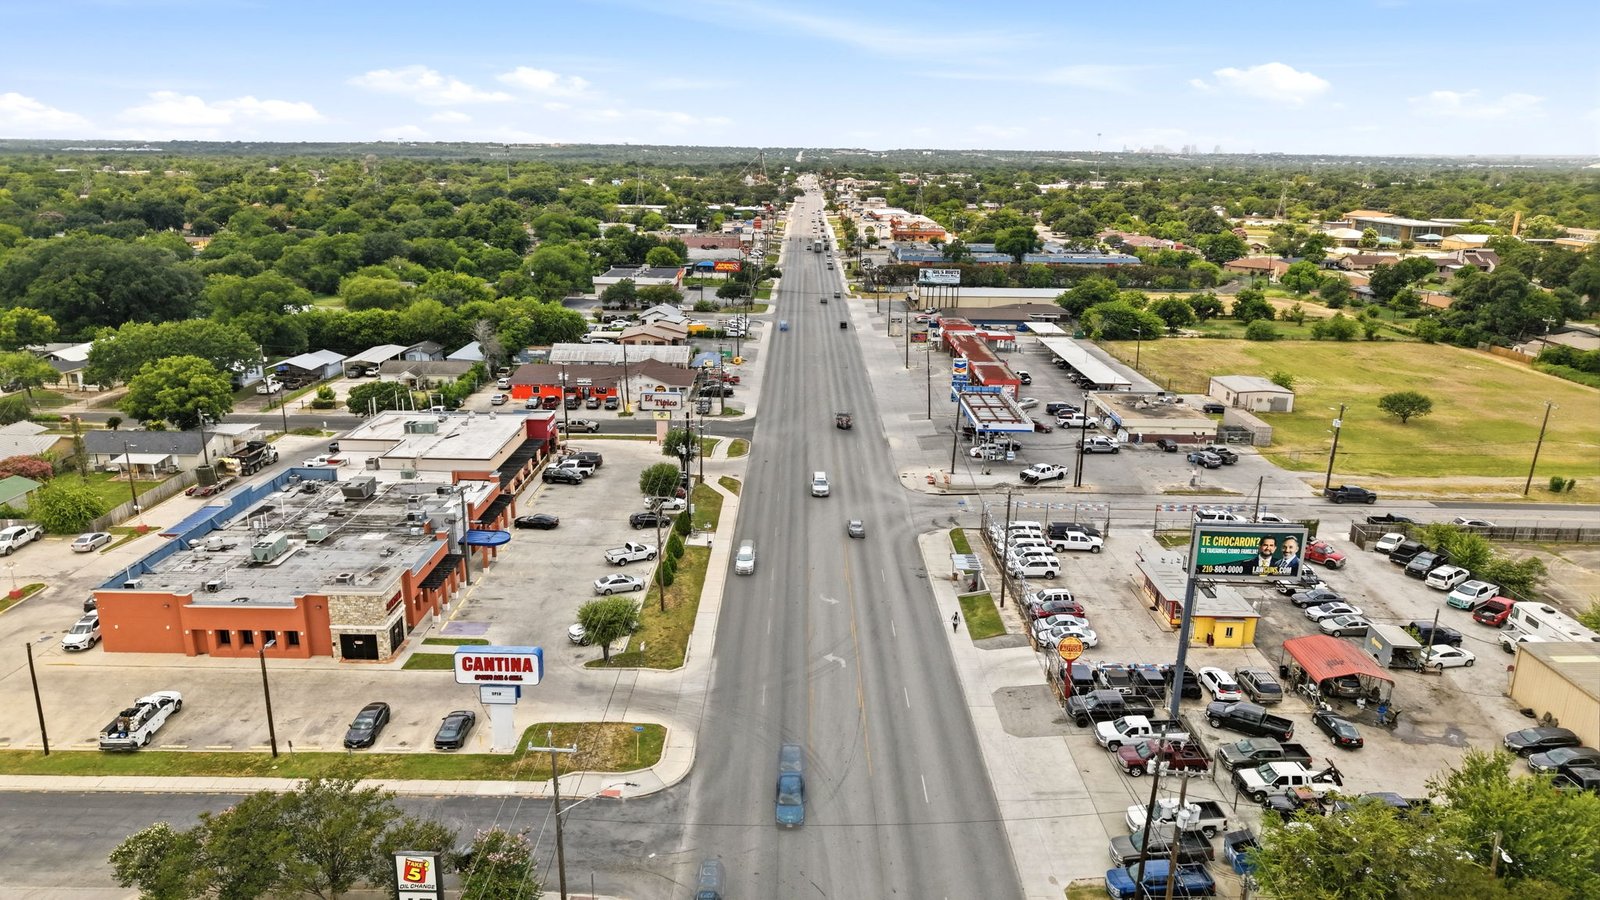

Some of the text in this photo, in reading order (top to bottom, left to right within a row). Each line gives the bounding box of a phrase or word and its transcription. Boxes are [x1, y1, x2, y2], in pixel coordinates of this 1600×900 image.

[1202, 536, 1261, 547] TE CHOCARON?
[1202, 565, 1243, 573] 210-800-0000
[462, 657, 533, 672] CANTINA
[407, 868, 421, 881] 5
